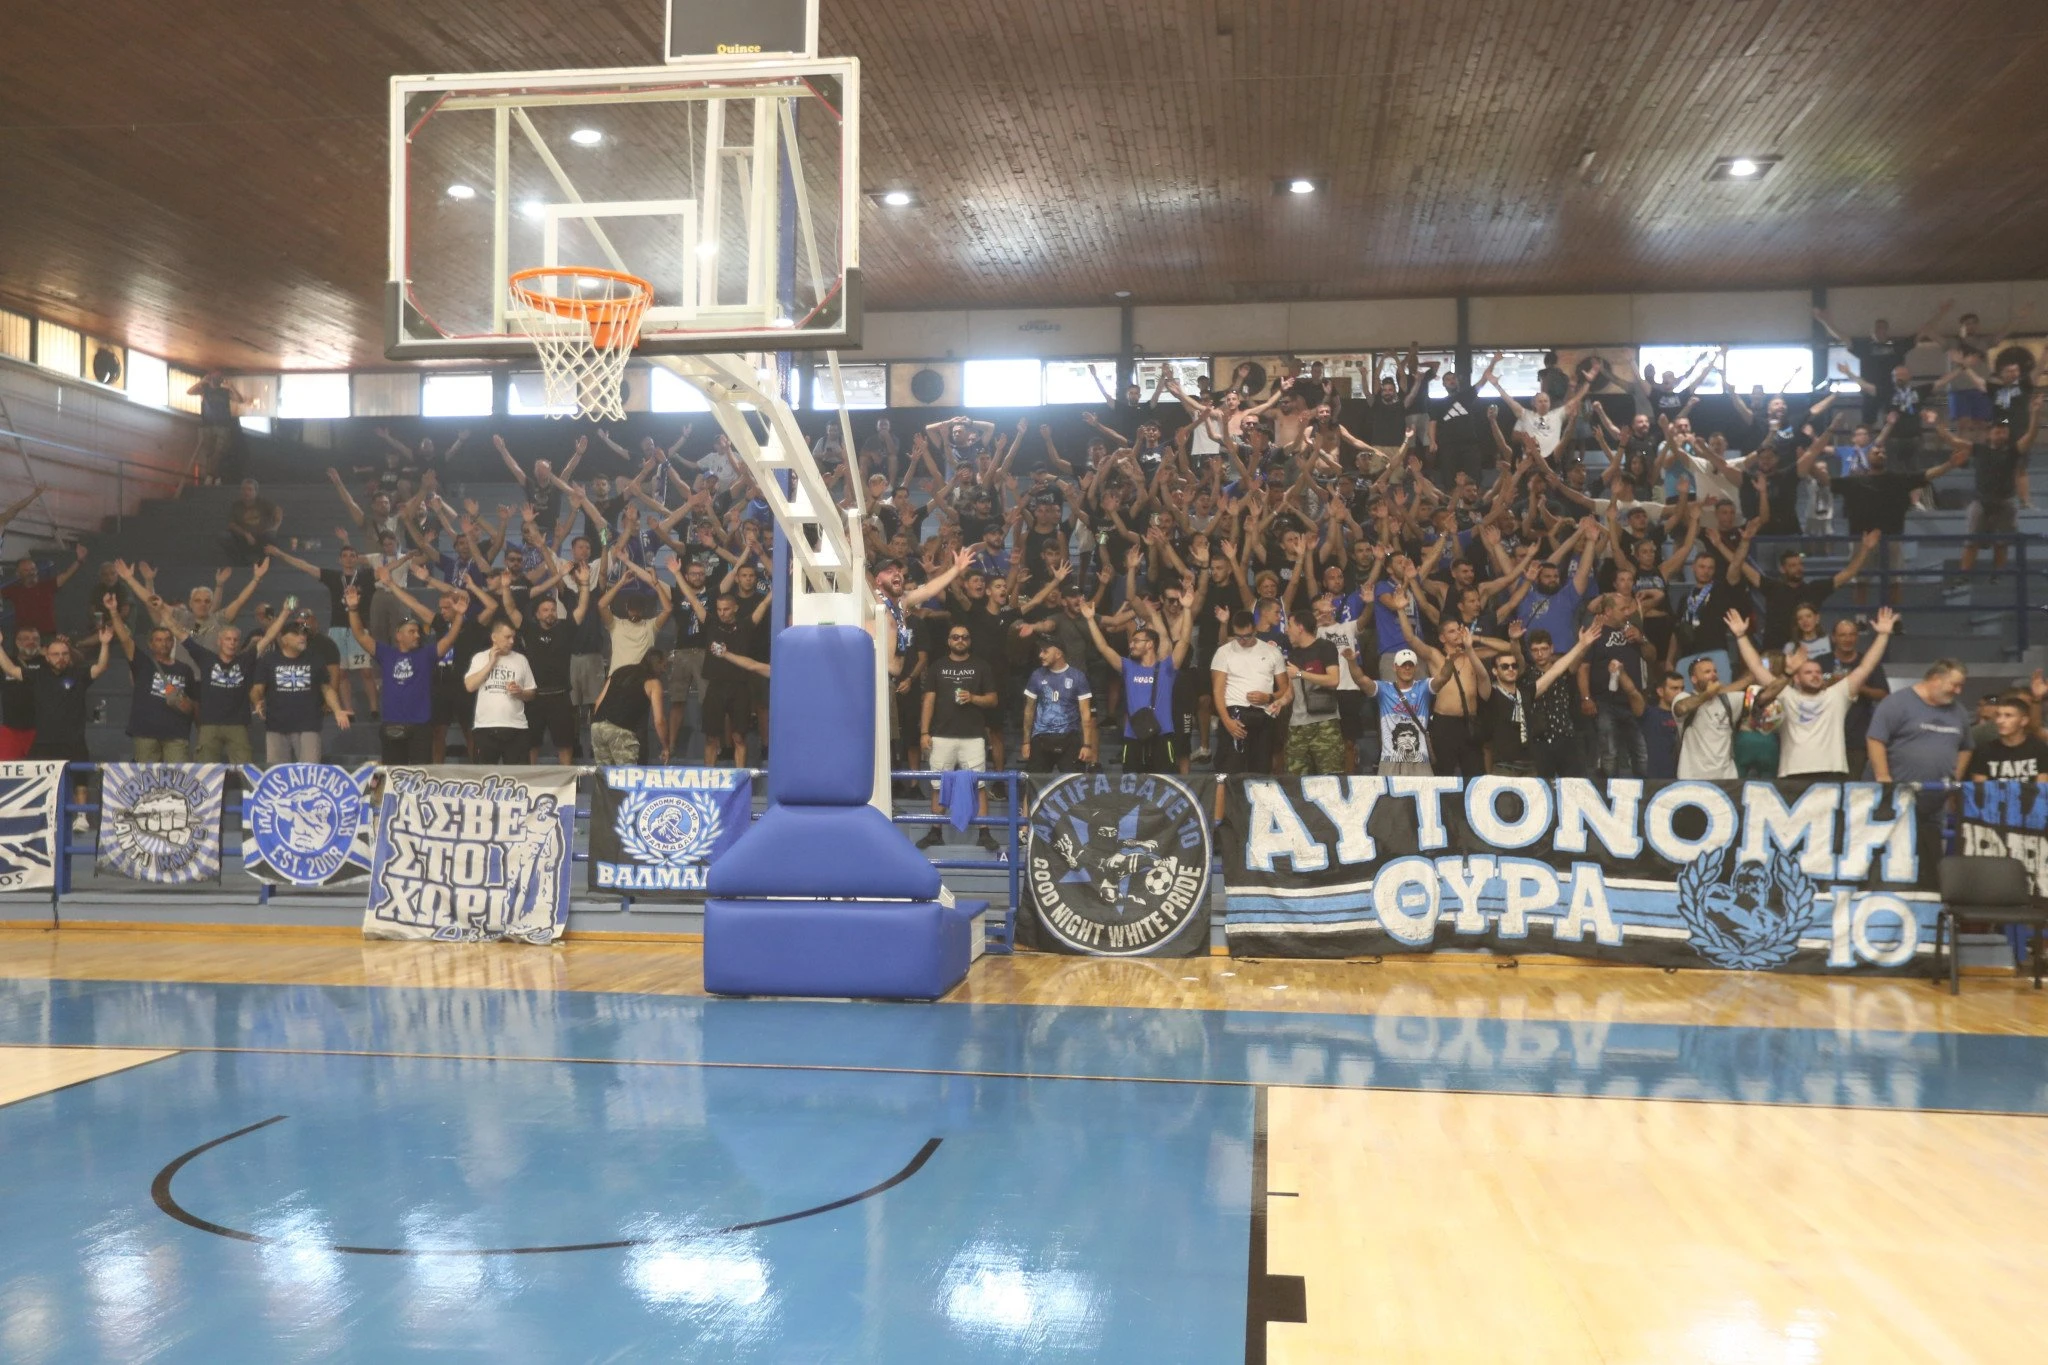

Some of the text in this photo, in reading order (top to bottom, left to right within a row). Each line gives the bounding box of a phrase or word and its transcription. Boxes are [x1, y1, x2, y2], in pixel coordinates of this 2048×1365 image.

[716, 43, 761, 54] Quince
[1133, 676, 1154, 684] HUGO
[1183, 713, 1192, 734] NIKE
[0, 765, 24, 777] TE
[288, 765, 350, 798] ATHENS
[608, 767, 734, 789] ΗΡΑΚΛΗΣ
[1986, 758, 2038, 778] TAKE
[392, 794, 529, 843] ΑΣΒΕ
[1033, 773, 1112, 844] ANTIFA
[1119, 773, 1190, 821] GATE
[113, 822, 151, 867] ANTI
[1244, 774, 1919, 884] ΑΥΤΟΝΟΜΗ
[387, 832, 486, 886] ΣΤΟ
[999, 851, 1009, 862] A
[378, 875, 508, 932] ΧΩΡΙ
[1033, 856, 1202, 948] GOOD NIGHT WHITE PRIDE
[1372, 854, 1918, 968] ΘΥΡΑ 10
